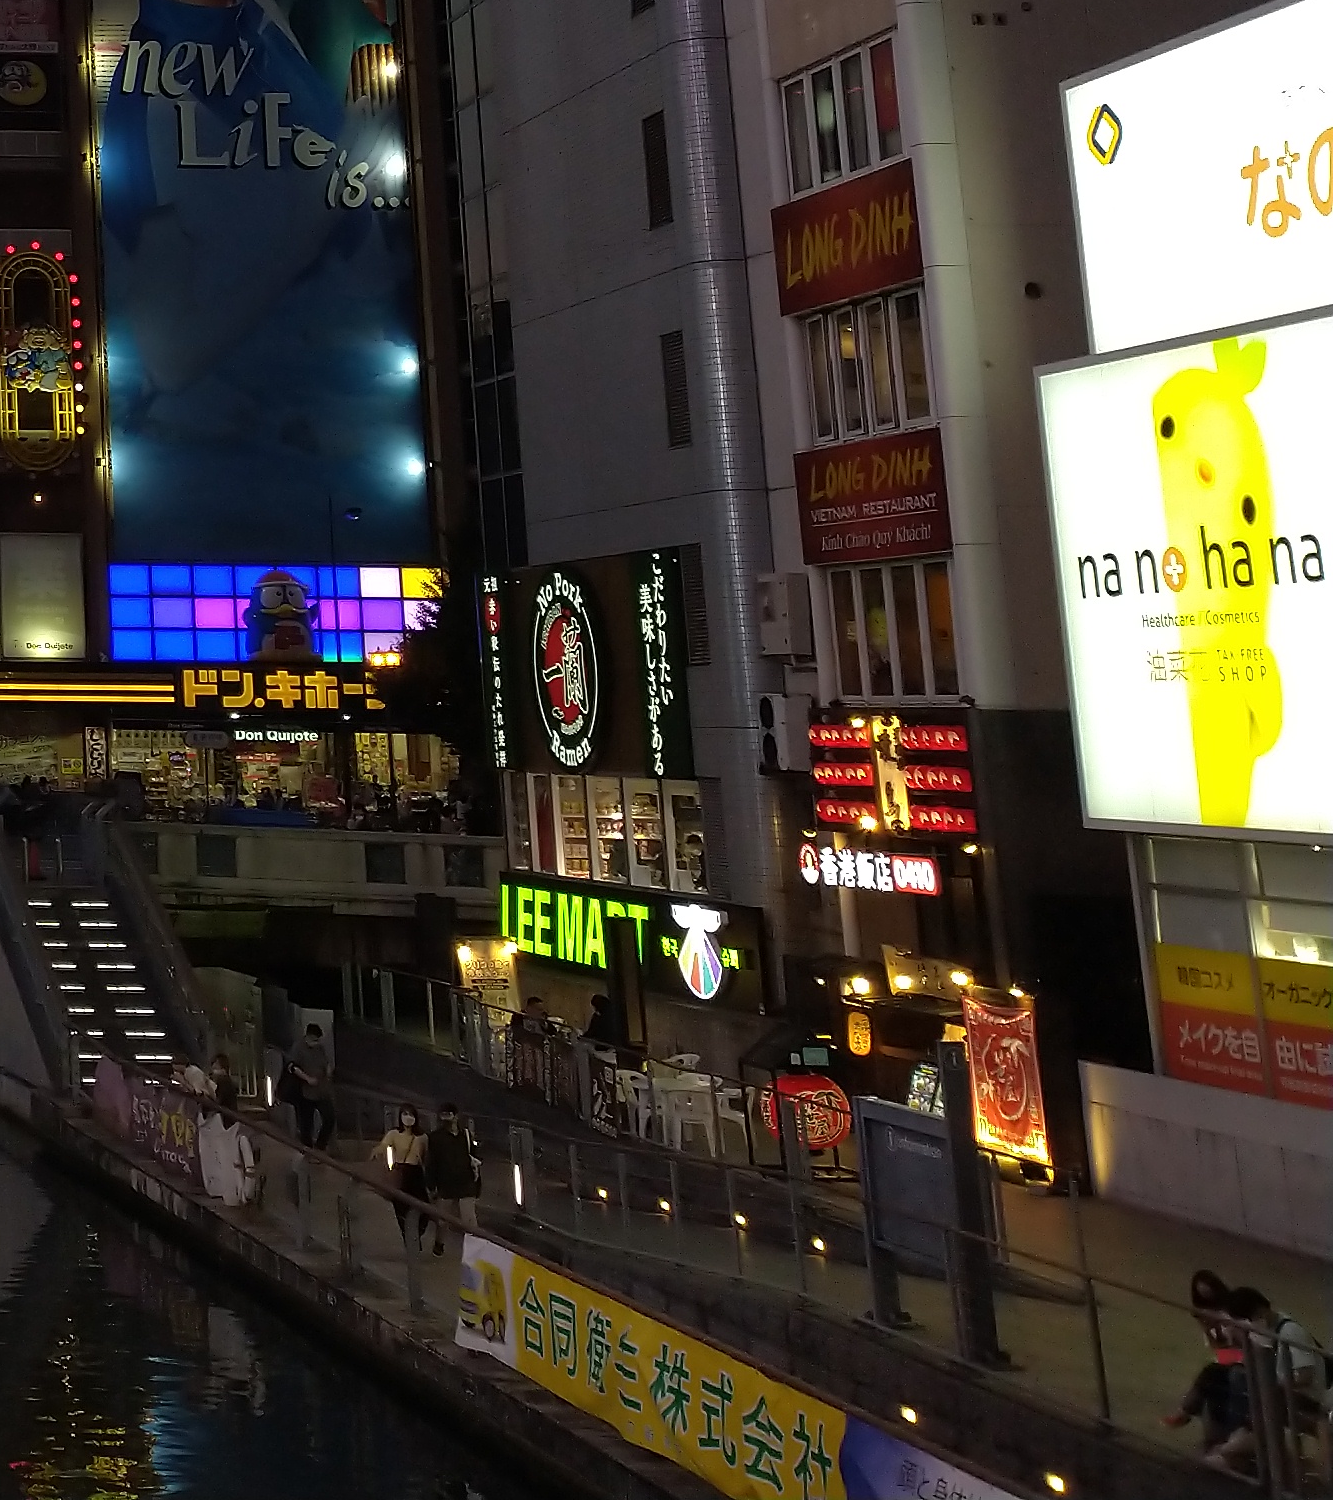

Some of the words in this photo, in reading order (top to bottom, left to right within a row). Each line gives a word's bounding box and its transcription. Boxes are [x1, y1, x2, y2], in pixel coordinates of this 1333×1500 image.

[121, 38, 257, 97] new
[786, 214, 845, 289] LONG
[848, 192, 912, 266] DINH
[809, 457, 866, 501] LONG
[871, 445, 933, 491] DINH
[810, 506, 857, 523] VIETNAM
[862, 493, 937, 516] RESTAURANT
[536, 585, 554, 616] No
[553, 572, 583, 613] Pork
[651, 553, 674, 706] こだわりたい
[1141, 614, 1195, 628] Healthcare
[1206, 610, 1261, 626] Cosmetics
[639, 583, 664, 776] 美味しさがある
[1219, 665, 1268, 683] SHOP
[235, 730, 263, 741] Don
[267, 730, 318, 743] Quijote
[550, 729, 592, 767] Ramen
[820, 847, 894, 893] 香港飯店
[501, 884, 552, 957] LEE
